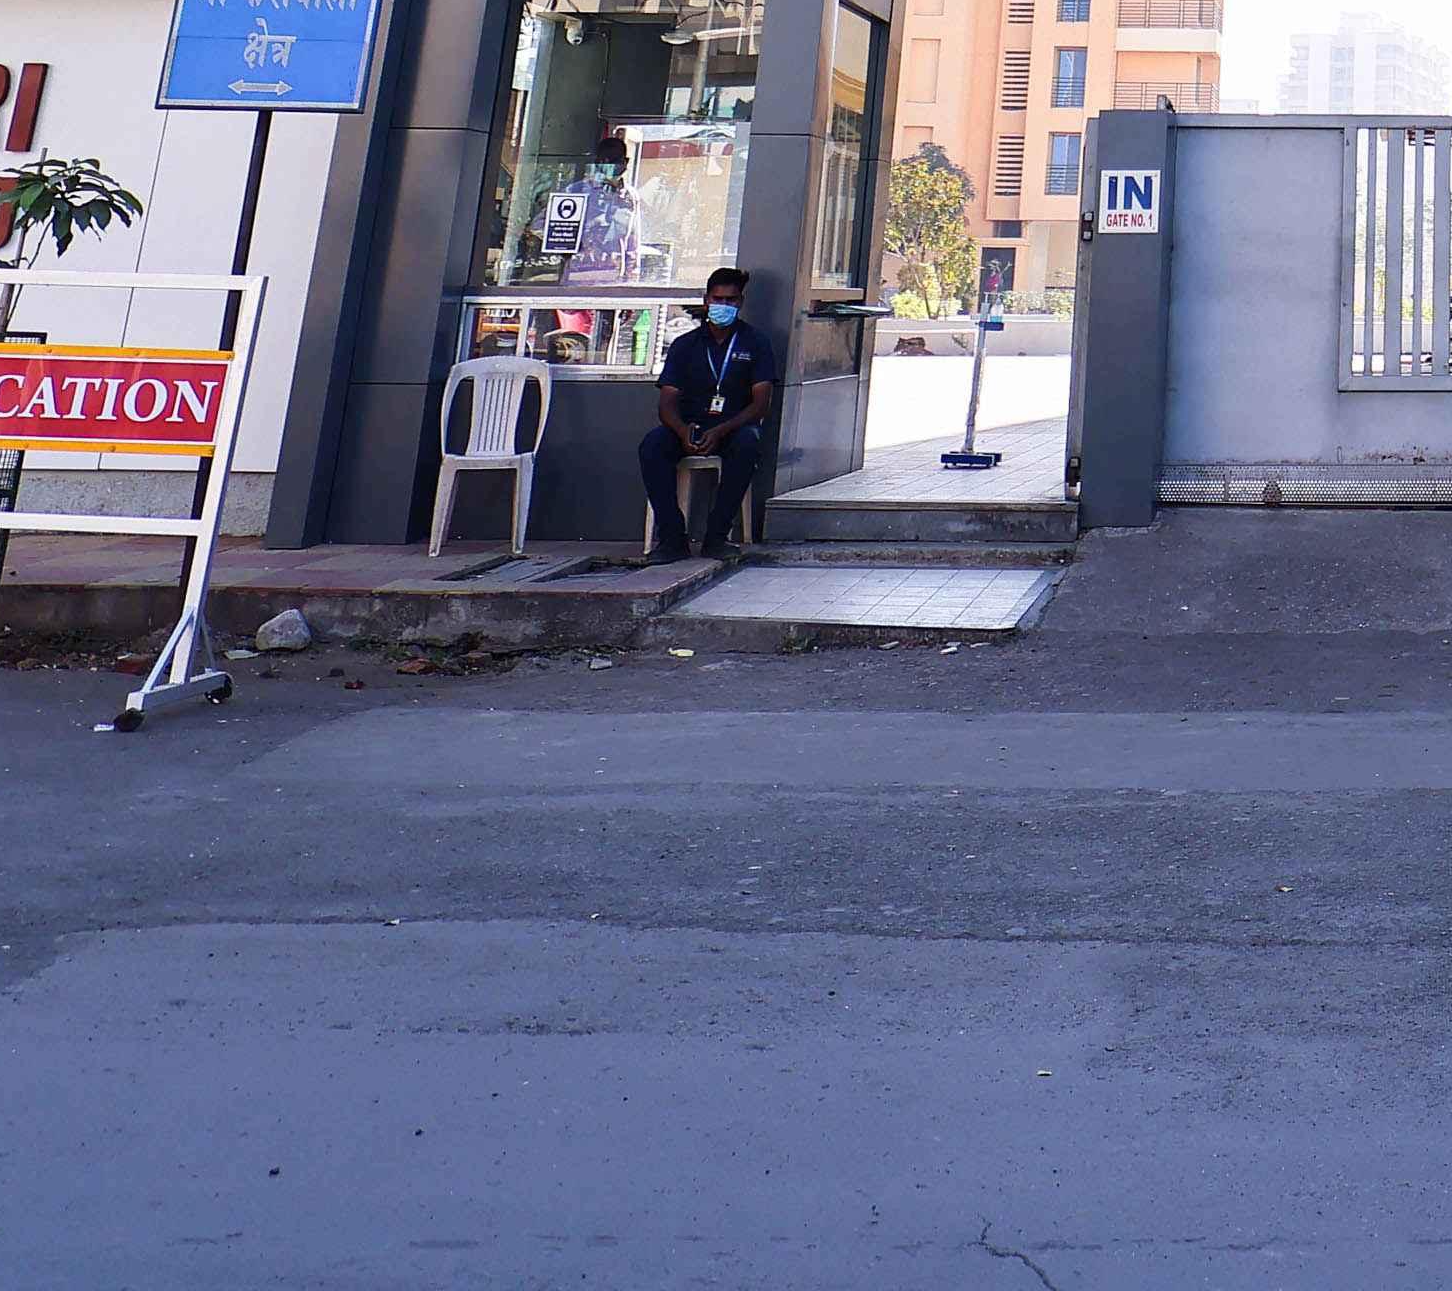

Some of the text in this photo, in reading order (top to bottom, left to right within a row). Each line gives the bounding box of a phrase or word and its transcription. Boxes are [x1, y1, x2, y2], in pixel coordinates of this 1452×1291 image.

[243, 17, 297, 69] क्षेत्र
[1107, 176, 1153, 210] IN
[1106, 213, 1129, 227] GATE
[1131, 213, 1146, 228] NO.
